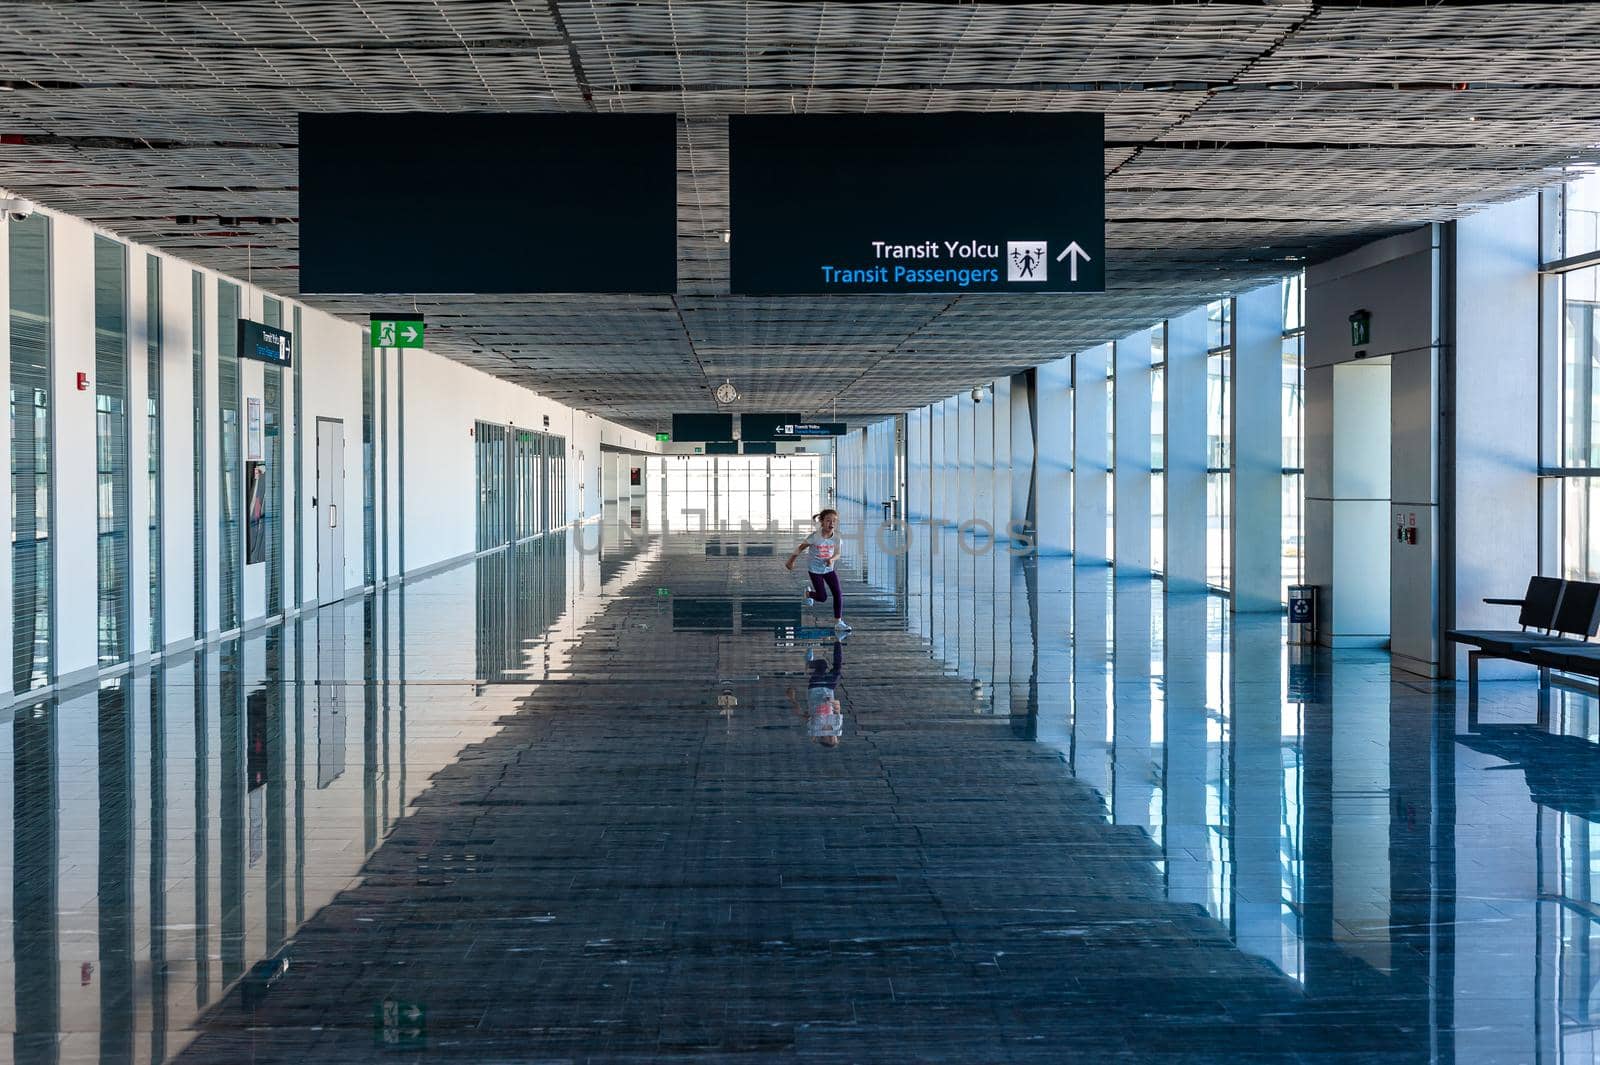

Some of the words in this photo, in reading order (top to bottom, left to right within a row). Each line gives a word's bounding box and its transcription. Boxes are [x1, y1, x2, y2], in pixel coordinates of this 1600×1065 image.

[872, 240, 939, 259] Transit
[944, 240, 999, 259] Yolcu
[821, 265, 889, 283] Transit
[894, 265, 999, 287] Passengers
